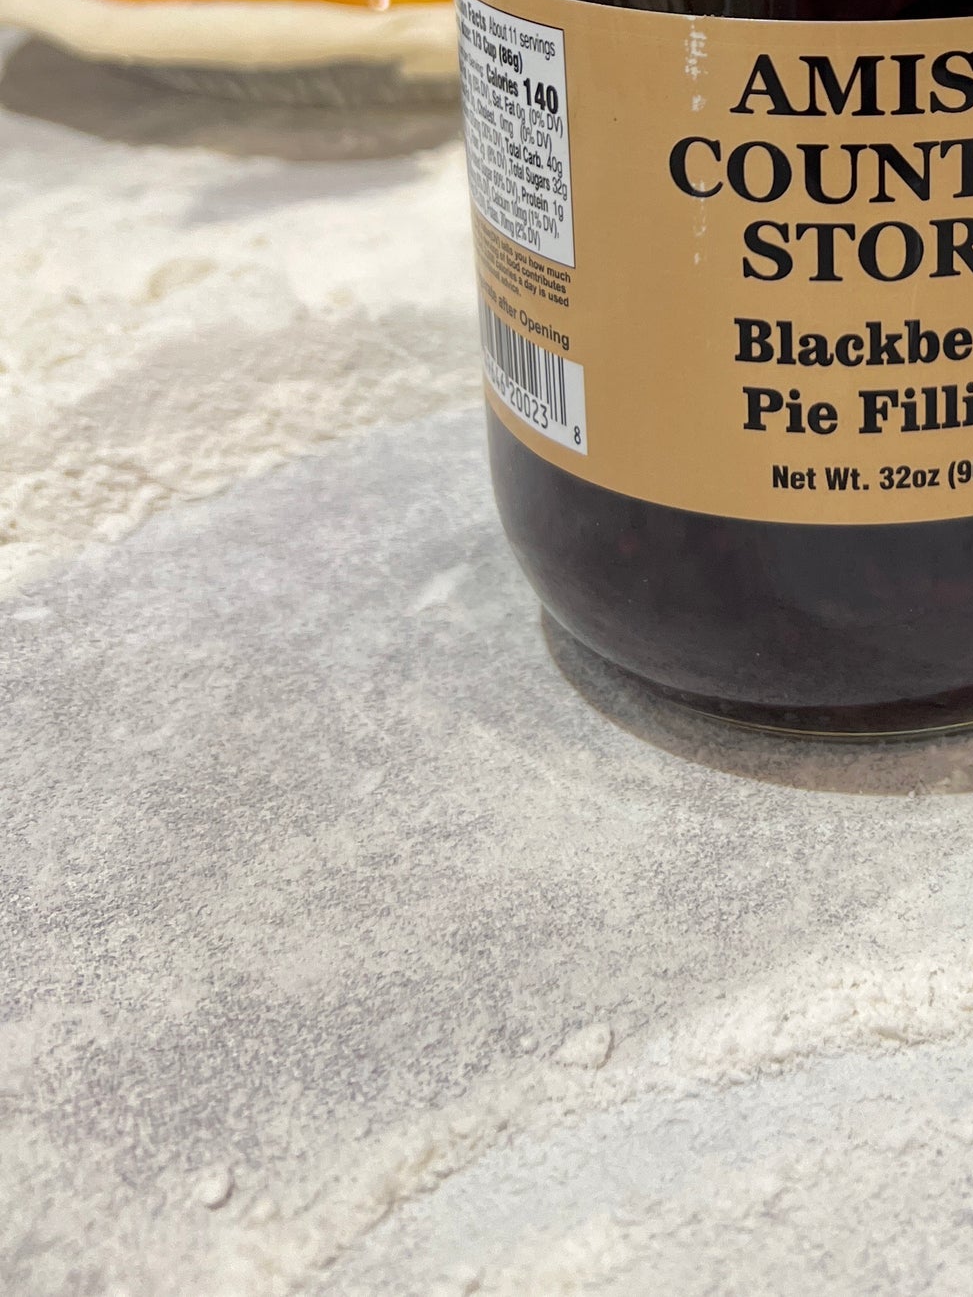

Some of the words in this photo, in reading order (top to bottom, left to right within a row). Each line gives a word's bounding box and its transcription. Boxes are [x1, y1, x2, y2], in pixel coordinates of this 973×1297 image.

[483, 36, 497, 62] Cup
[499, 44, 523, 74] (86g)
[489, 16, 507, 42] About
[509, 26, 518, 45] 11
[520, 32, 556, 60] servings
[486, 63, 519, 97] Calories
[523, 78, 559, 114] 140
[505, 96, 515, 116] Fat
[547, 113, 563, 139] DV)
[505, 137, 521, 160] Total
[523, 146, 544, 170] Carb.
[547, 156, 562, 178] 40g
[526, 166, 550, 191] Sugars
[552, 177, 568, 201] 32g
[521, 186, 548, 213] Protein
[553, 200, 564, 222] 1g
[514, 250, 527, 264] you
[529, 258, 545, 273] how
[547, 266, 571, 284] much
[522, 266, 566, 294] contributes
[524, 279, 537, 296] day
[548, 293, 570, 308] used
[498, 295, 517, 319] after
[519, 310, 570, 351] Opening
[742, 385, 838, 435] Pie
[573, 425, 582, 445] 8
[772, 464, 816, 490] Net
[825, 466, 869, 491] Wt.
[878, 465, 940, 490] 32oz
